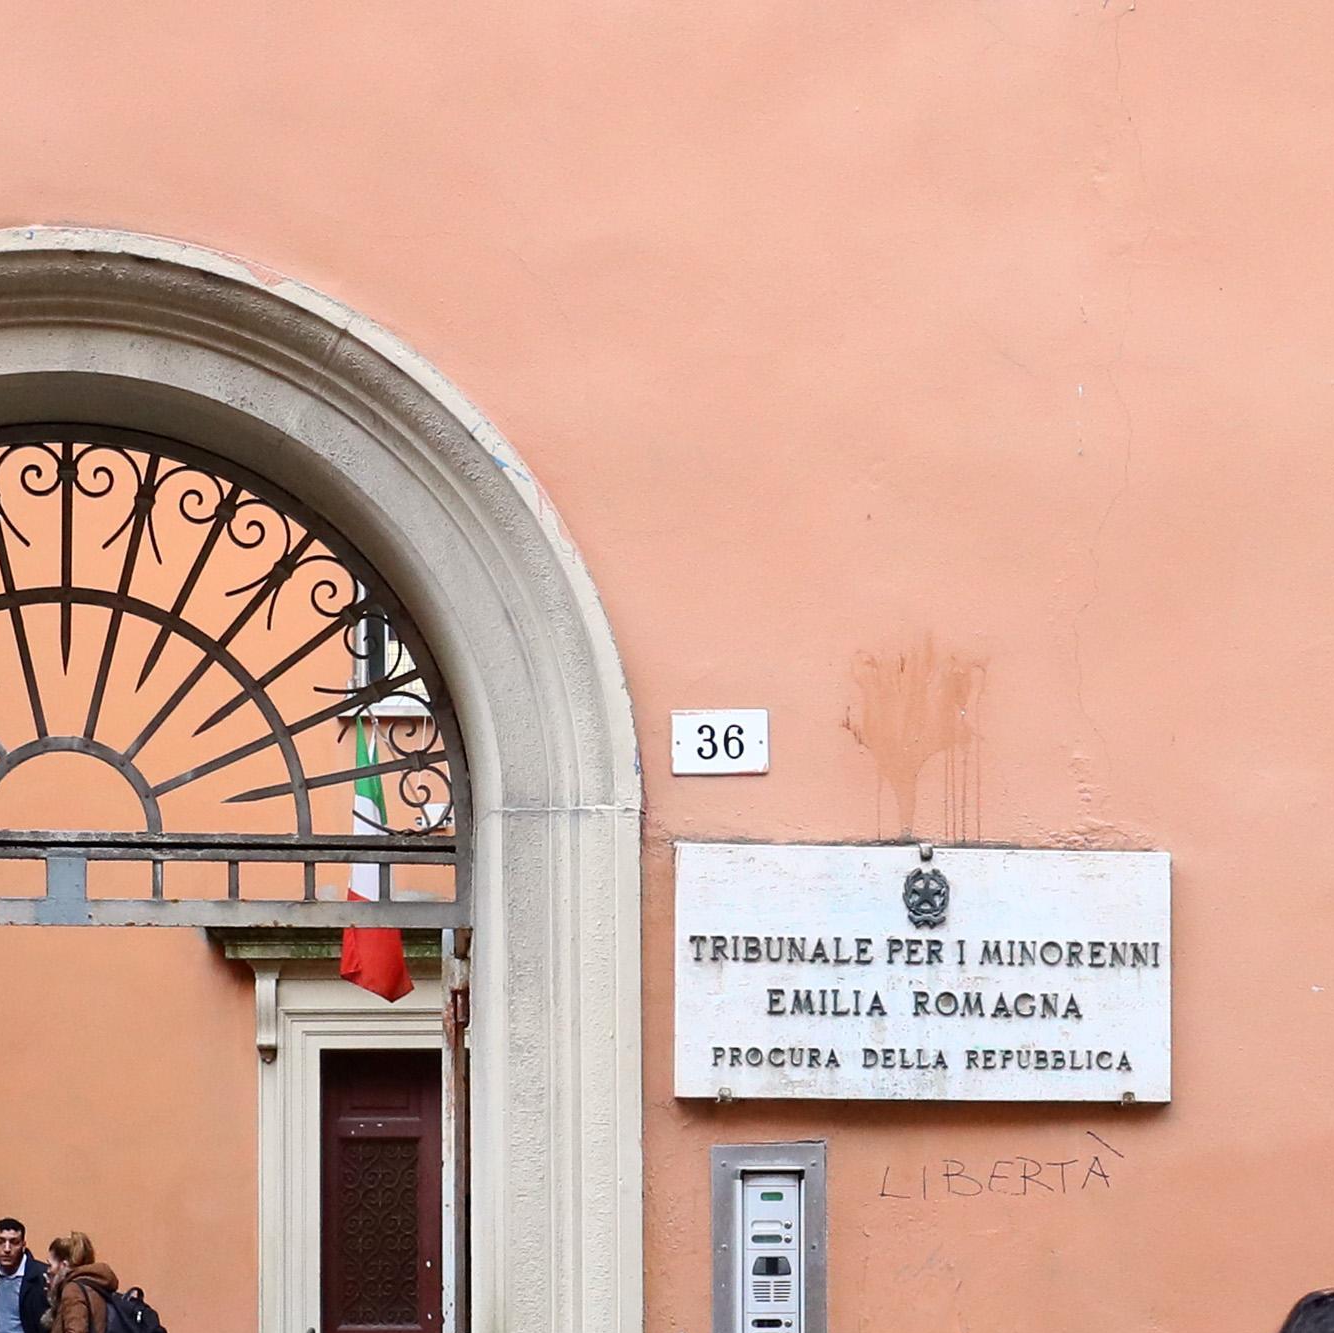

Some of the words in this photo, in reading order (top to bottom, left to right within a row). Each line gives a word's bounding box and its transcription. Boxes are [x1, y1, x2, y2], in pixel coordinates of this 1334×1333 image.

[696, 724, 745, 760] 36
[689, 935, 874, 965] TRIBUNALE
[886, 938, 944, 966] PER
[957, 939, 966, 966] I
[978, 940, 1161, 968] MINORENNI
[766, 988, 888, 1017] EMILIA
[912, 991, 1083, 1019] ROMAGNA
[711, 1047, 841, 1068] PROCURA
[861, 1048, 949, 1070] DELLA
[965, 1049, 1133, 1071] REPUBBLICA
[878, 1131, 1124, 1200] LIBERTÀ
